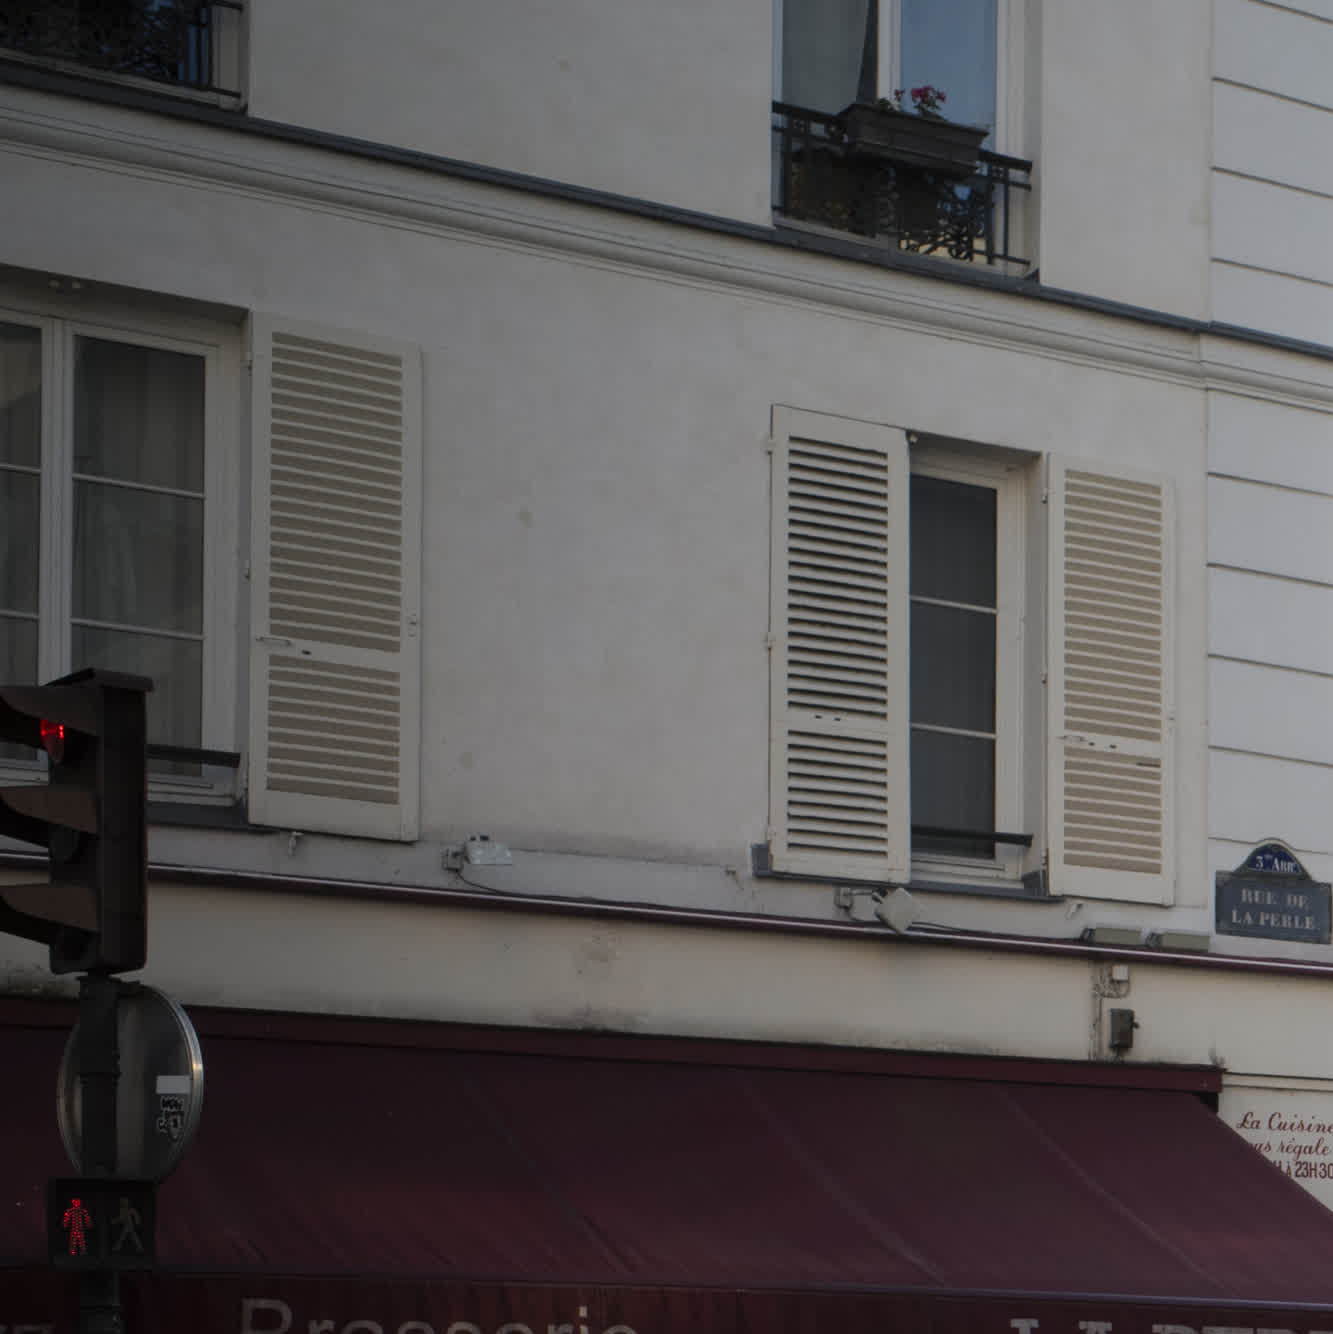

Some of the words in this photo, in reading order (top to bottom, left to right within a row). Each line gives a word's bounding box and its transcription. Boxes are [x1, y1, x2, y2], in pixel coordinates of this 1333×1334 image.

[1241, 888, 1276, 905] RUE
[1231, 909, 1253, 925] LA
[1259, 911, 1316, 929] PERLE
[1236, 1111, 1261, 1130] La
